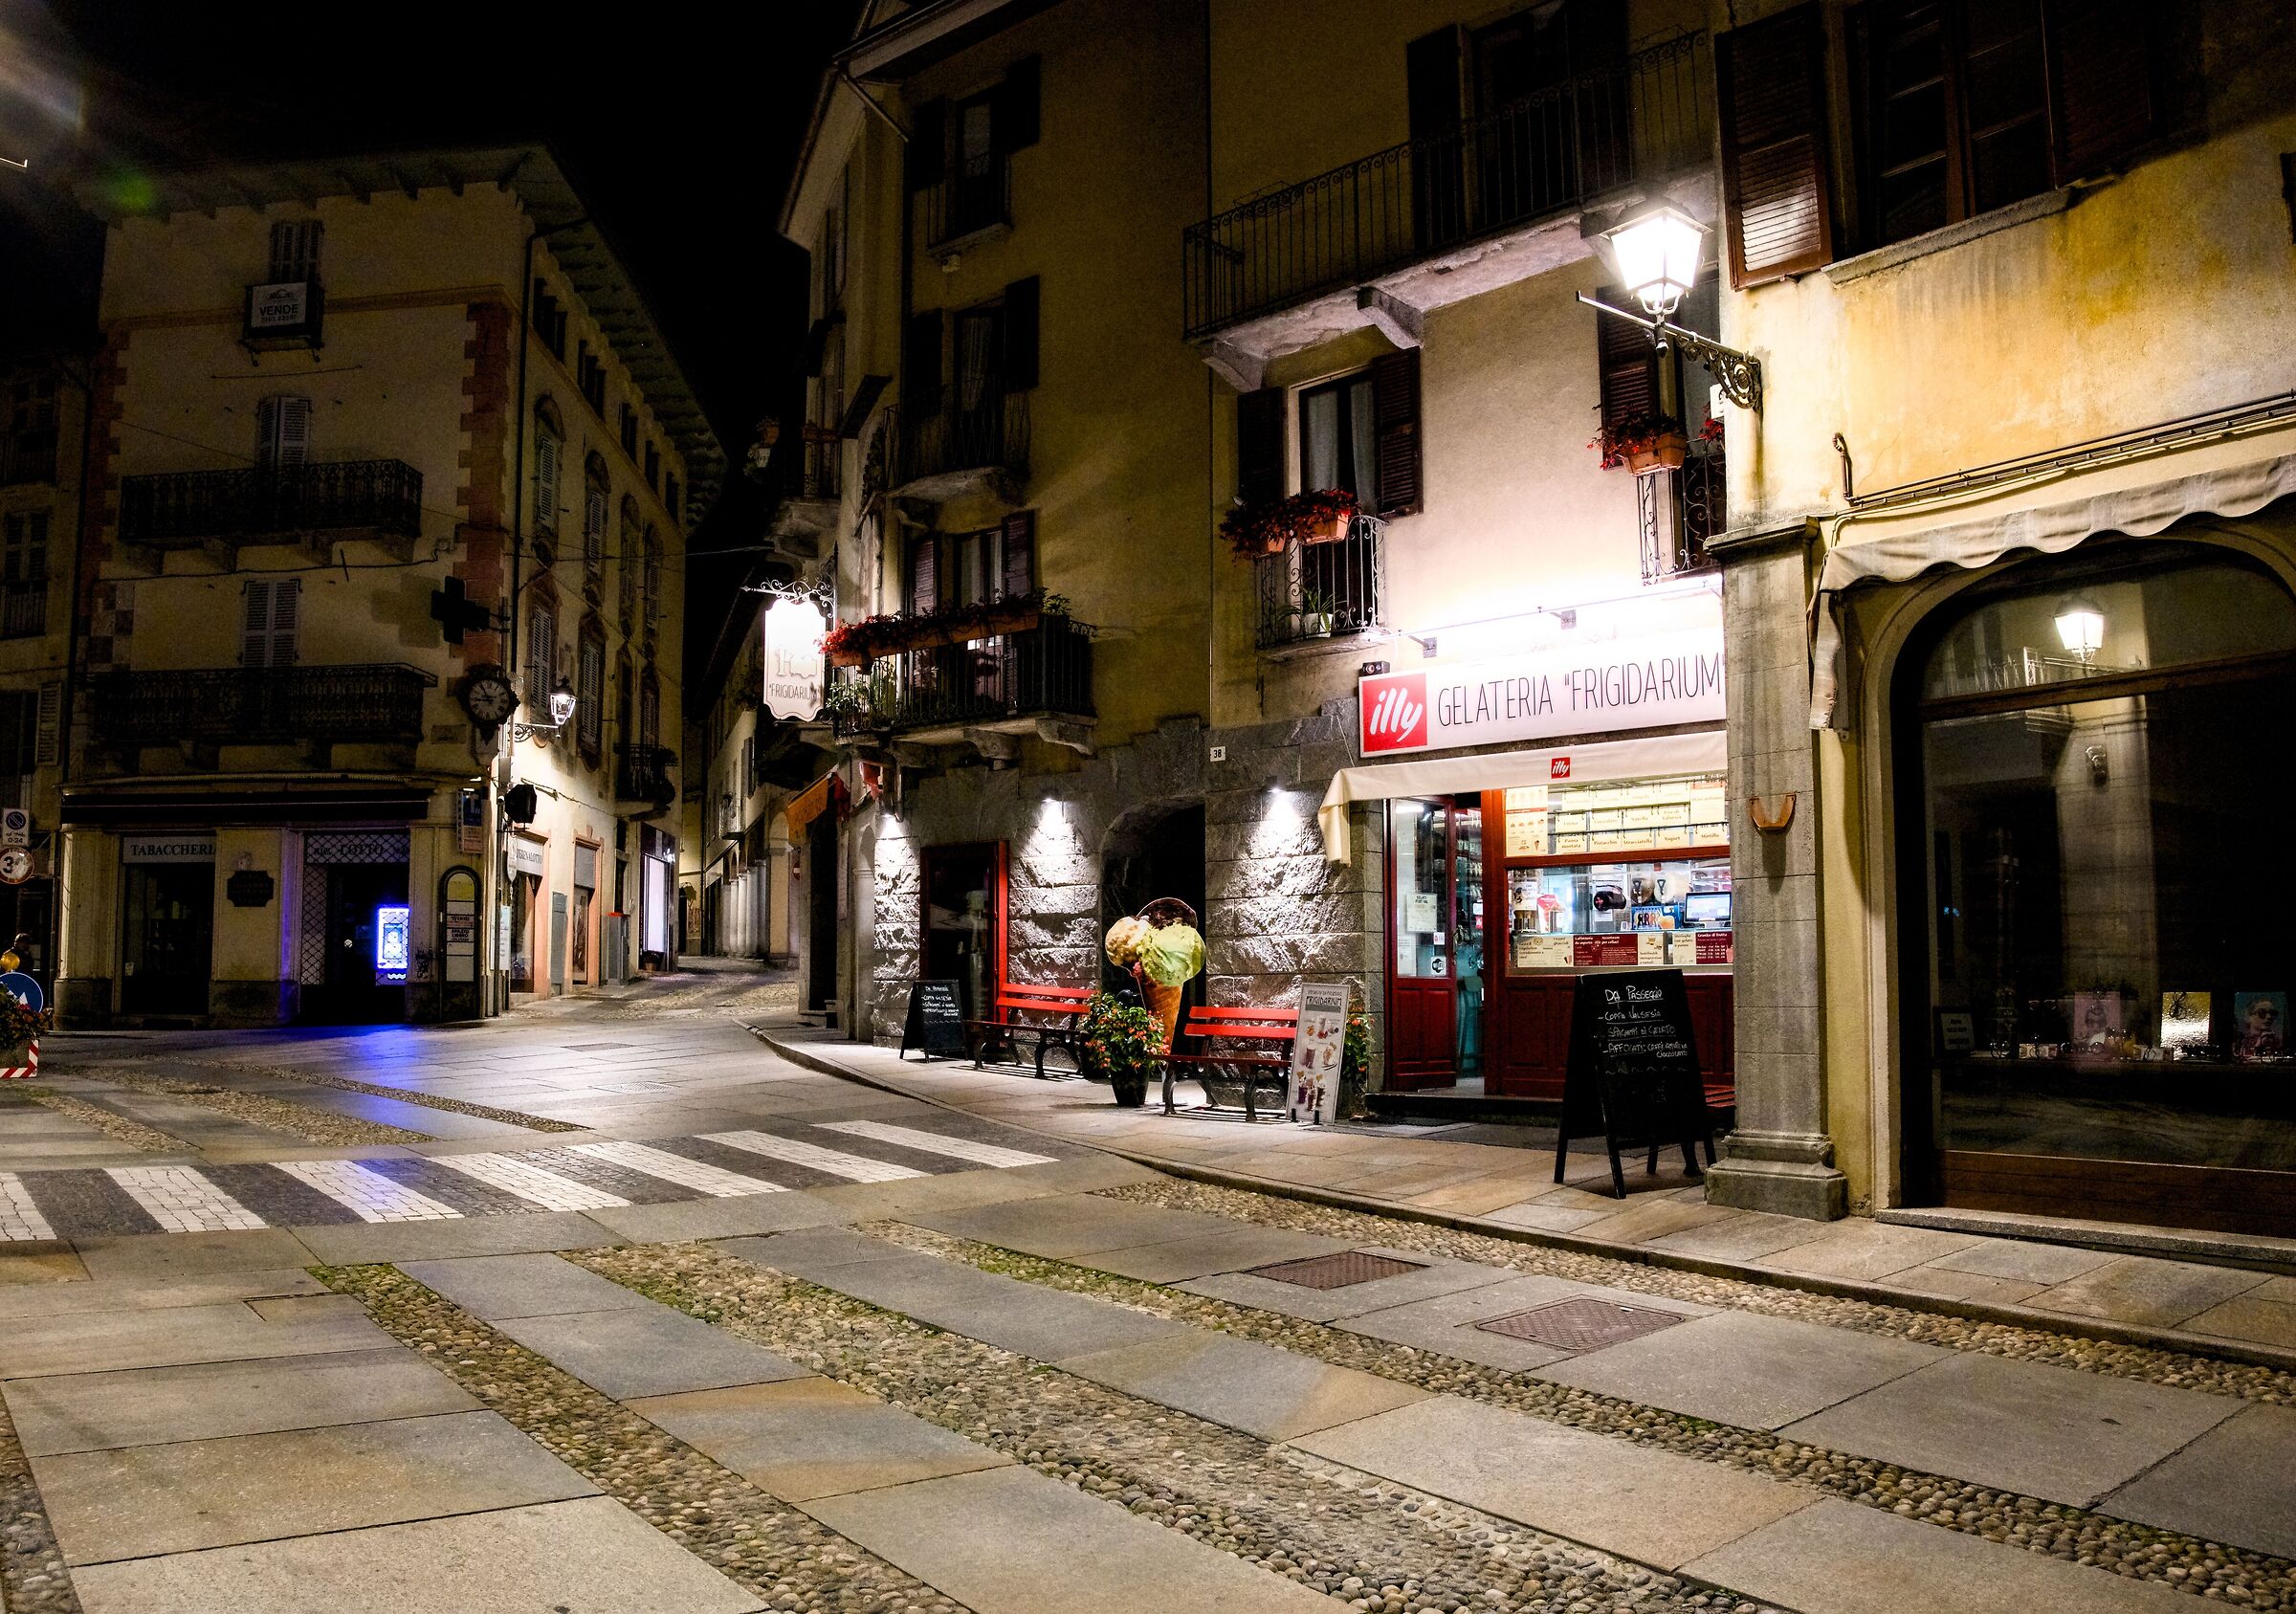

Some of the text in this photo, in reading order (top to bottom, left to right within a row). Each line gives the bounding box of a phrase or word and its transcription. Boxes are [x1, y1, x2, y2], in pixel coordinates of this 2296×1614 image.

[259, 304, 299, 316] VENDE
[1438, 674, 1554, 727] GELATERIA
[1369, 687, 1424, 742] illy
[1213, 748, 1223, 759] 38
[1552, 761, 1569, 777] illy
